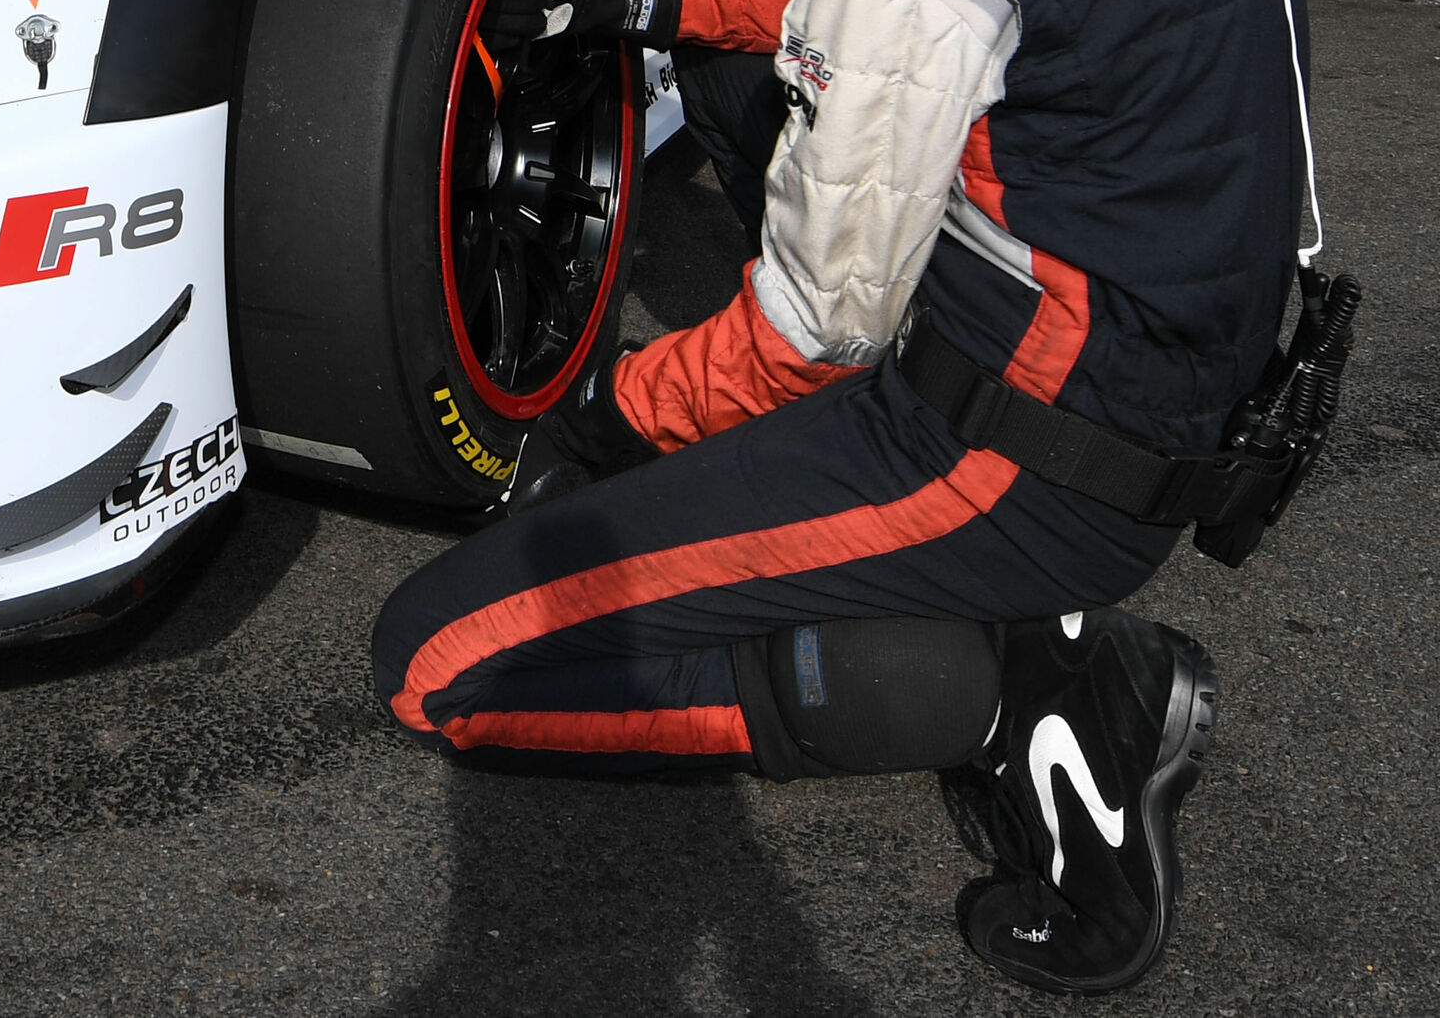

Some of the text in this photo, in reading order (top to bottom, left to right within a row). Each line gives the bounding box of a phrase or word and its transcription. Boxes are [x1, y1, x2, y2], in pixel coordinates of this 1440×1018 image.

[37, 186, 185, 270] R8
[102, 413, 240, 518] CZECH
[433, 387, 516, 481] PIRELLI
[113, 464, 238, 543] OUTDOOR
